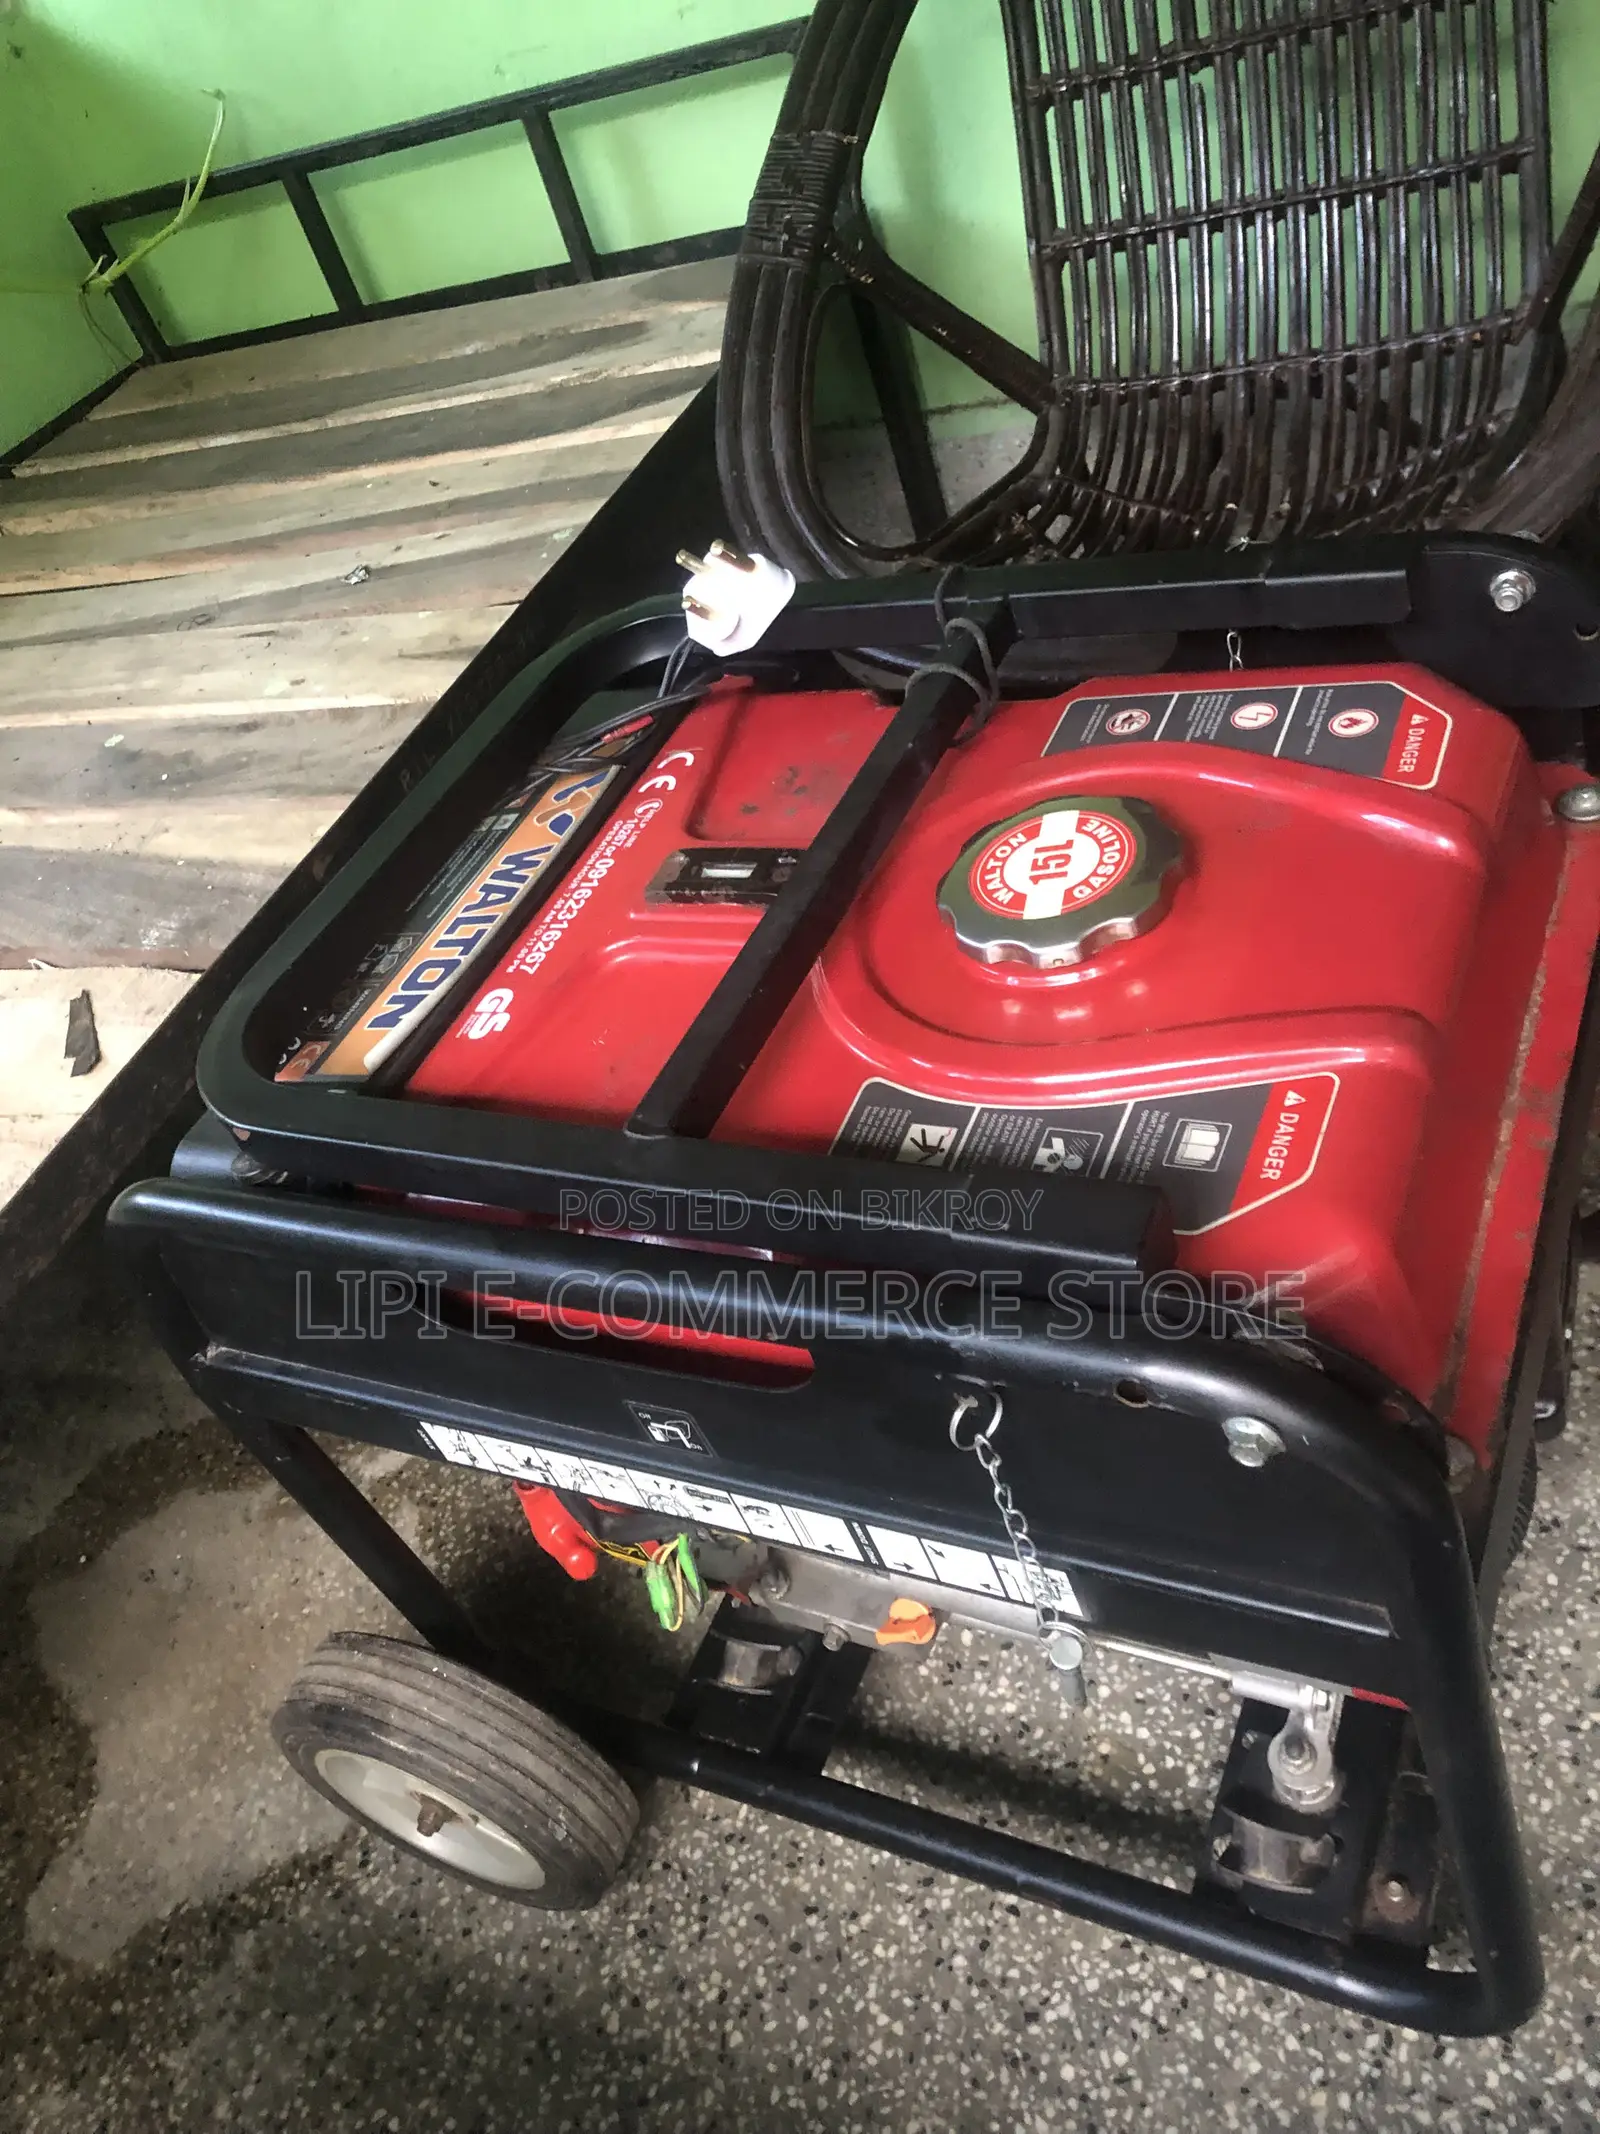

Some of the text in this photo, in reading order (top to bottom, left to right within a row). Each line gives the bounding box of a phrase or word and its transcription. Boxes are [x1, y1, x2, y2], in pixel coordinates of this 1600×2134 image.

[638, 752, 694, 793] CE
[1397, 727, 1425, 773] DANGER
[611, 818, 638, 847] 16267
[1029, 839, 1074, 886] 15L
[1073, 819, 1121, 899] GASOLINE
[984, 832, 1027, 905] WALTON
[364, 842, 559, 1031] WALTON
[520, 857, 615, 975] 09162316267
[1260, 1112, 1300, 1180] DANGER
